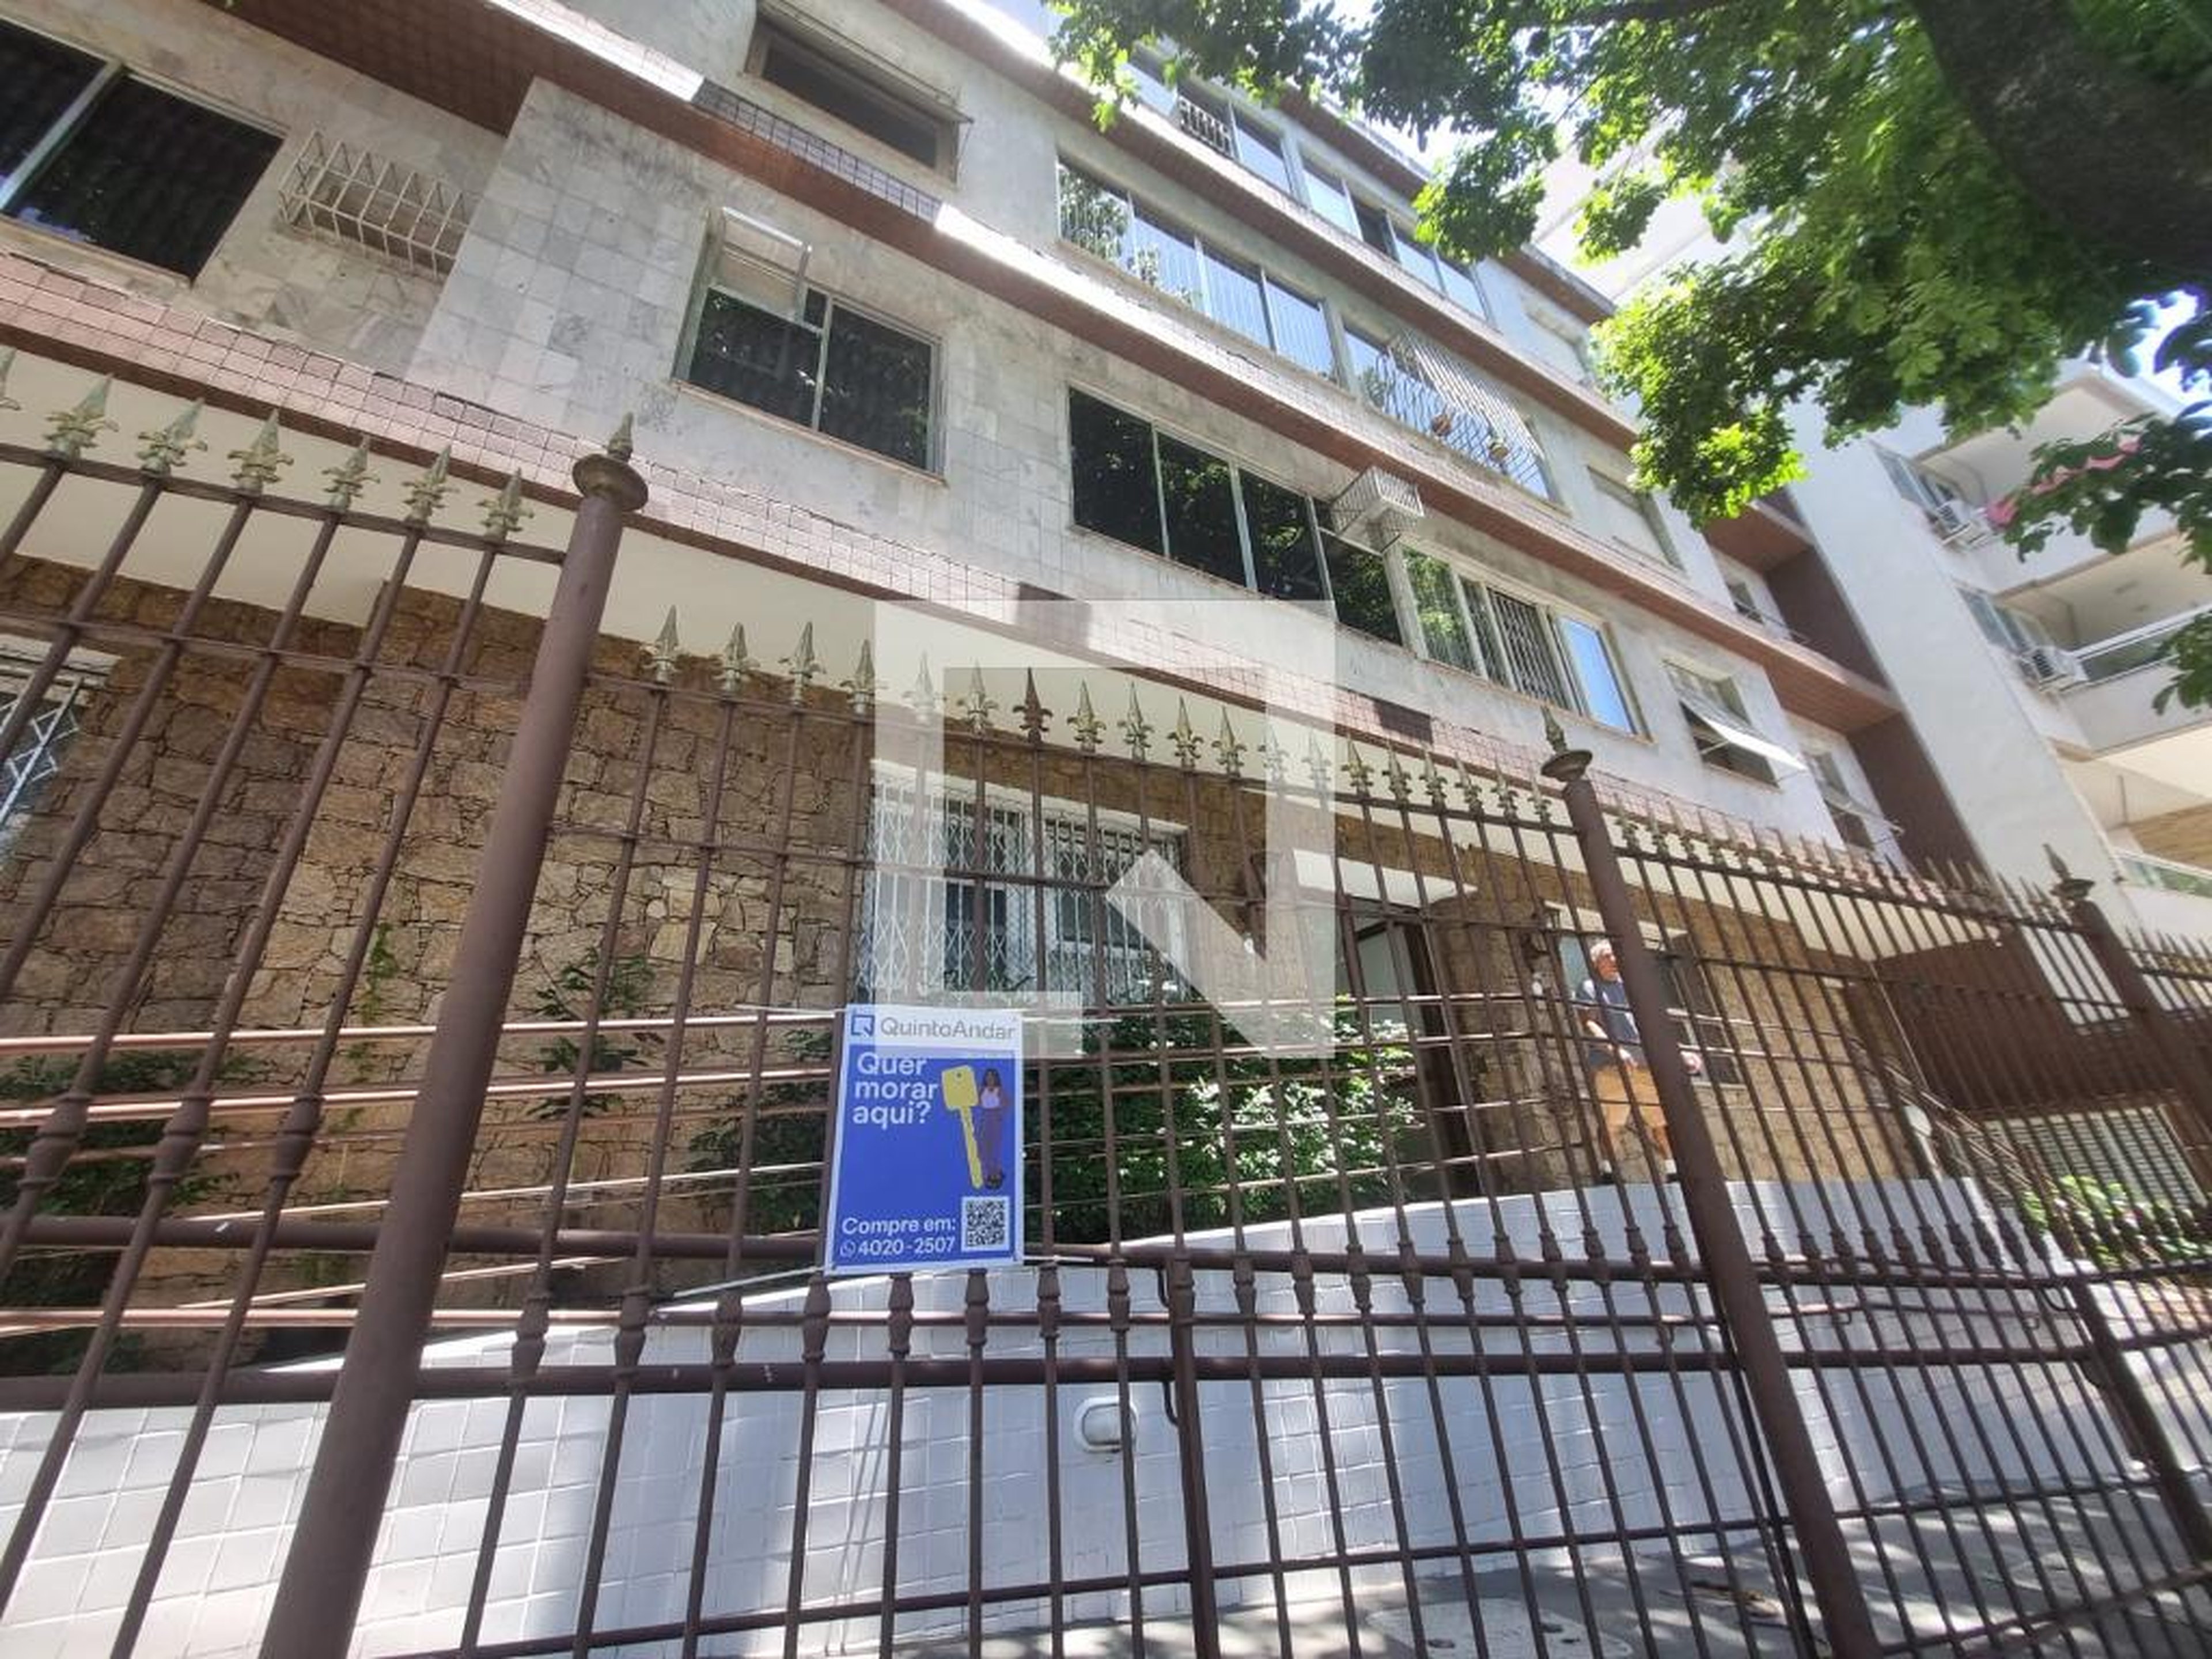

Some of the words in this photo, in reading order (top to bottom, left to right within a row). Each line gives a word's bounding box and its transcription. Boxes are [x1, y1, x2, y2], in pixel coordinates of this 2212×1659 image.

[880, 1016, 1016, 1040] QuintoAndar
[857, 1051, 927, 1076] Quer
[855, 1079, 938, 1100] morar
[853, 1100, 931, 1130] aqui?
[842, 1215, 919, 1237] Compre
[923, 1217, 956, 1233] em:
